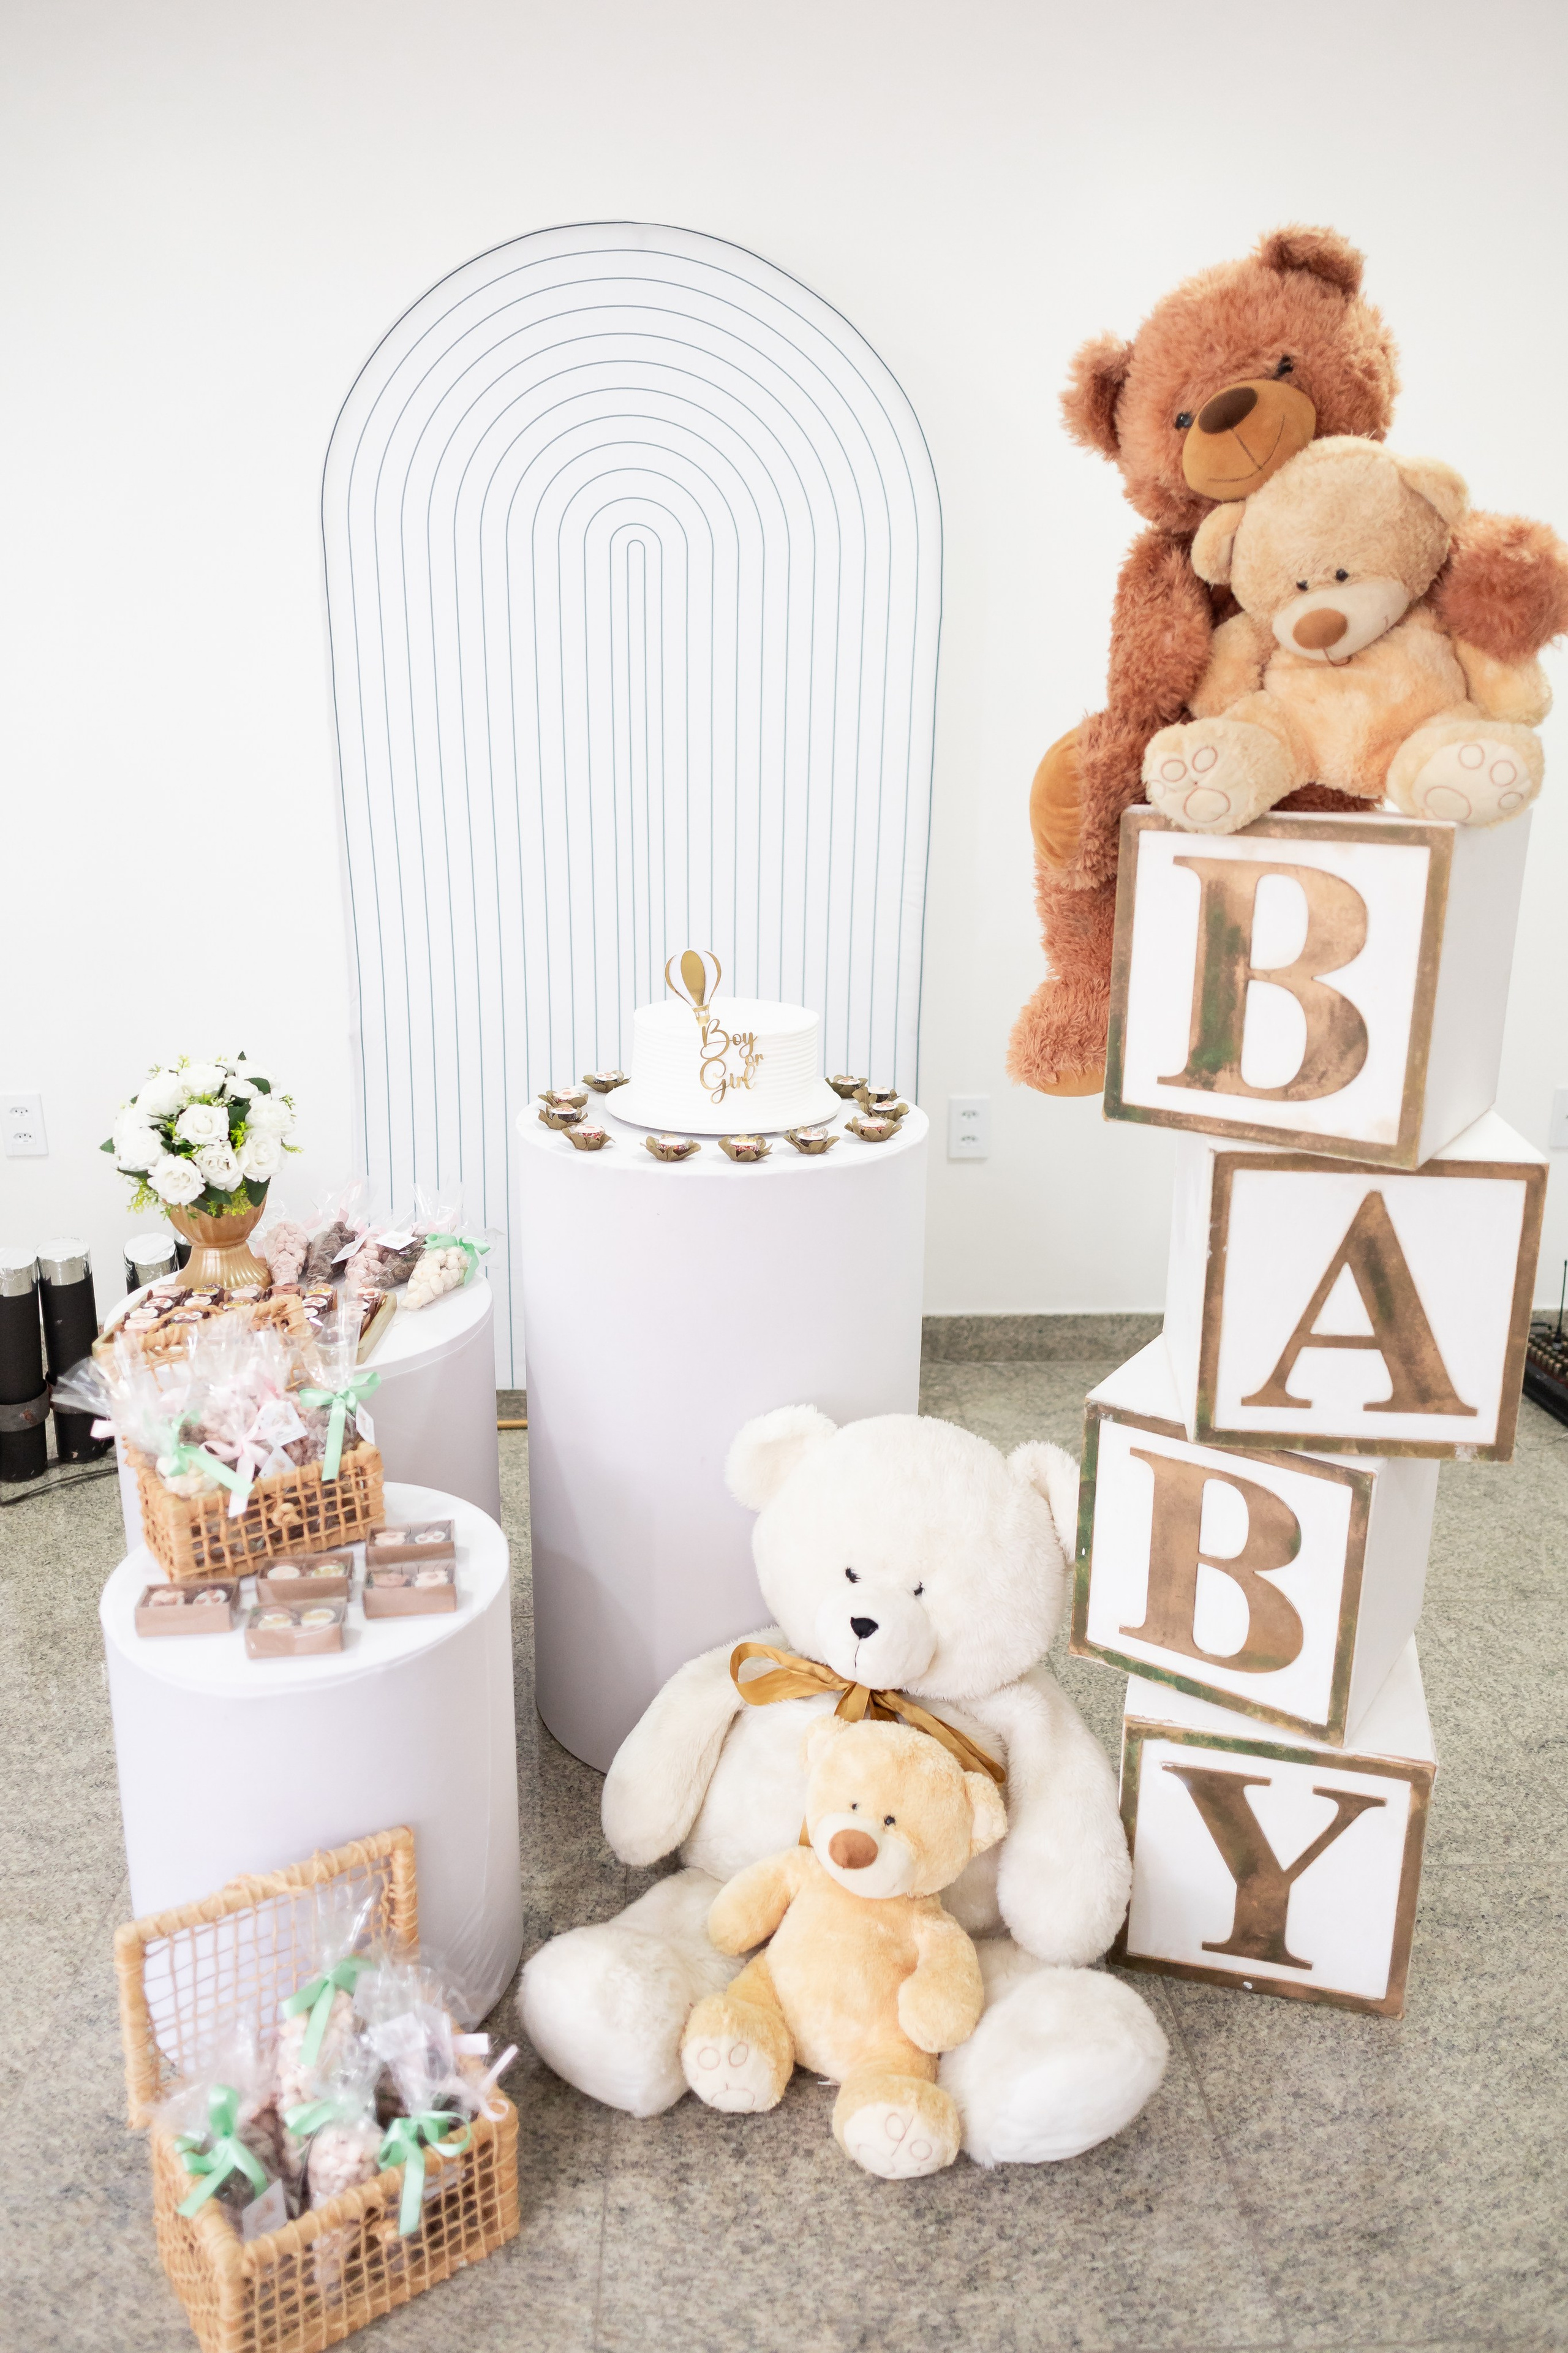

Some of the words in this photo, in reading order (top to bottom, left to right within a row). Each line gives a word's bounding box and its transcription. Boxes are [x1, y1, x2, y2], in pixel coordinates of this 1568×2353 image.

[700, 1019, 758, 1060] Boy
[700, 1058, 756, 1104] Girl
[745, 1054, 764, 1067] or
